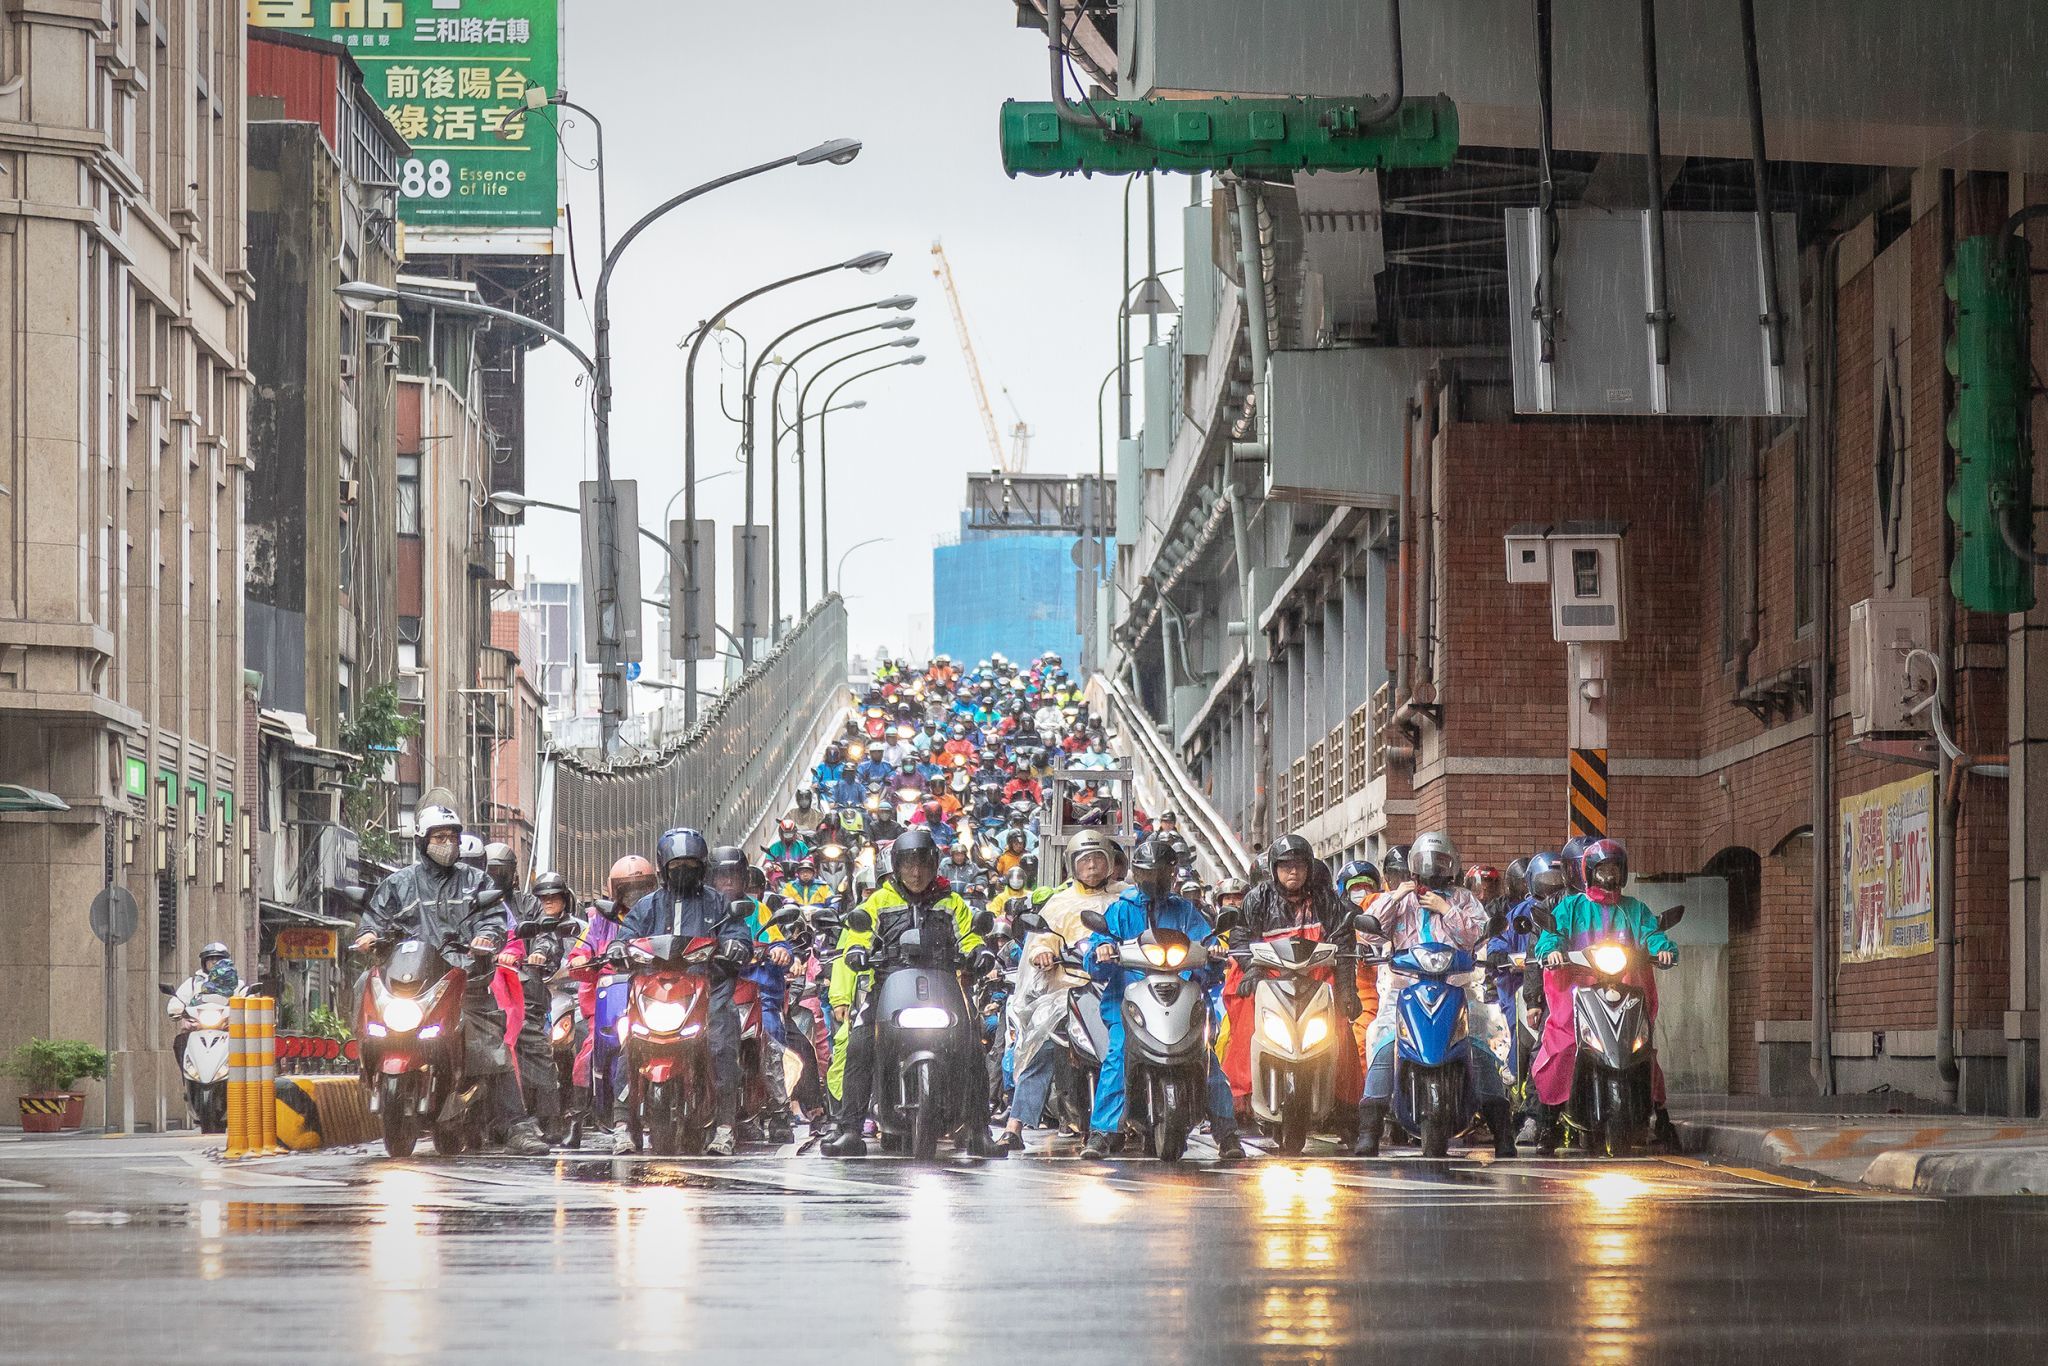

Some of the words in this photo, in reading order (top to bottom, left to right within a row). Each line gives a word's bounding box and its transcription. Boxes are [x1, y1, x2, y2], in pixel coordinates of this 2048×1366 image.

[413, 17, 529, 43] 三和路右轉
[385, 65, 527, 99] 前後陽台
[460, 168, 526, 181] Essence
[460, 182, 476, 195] of
[482, 182, 507, 195] life
